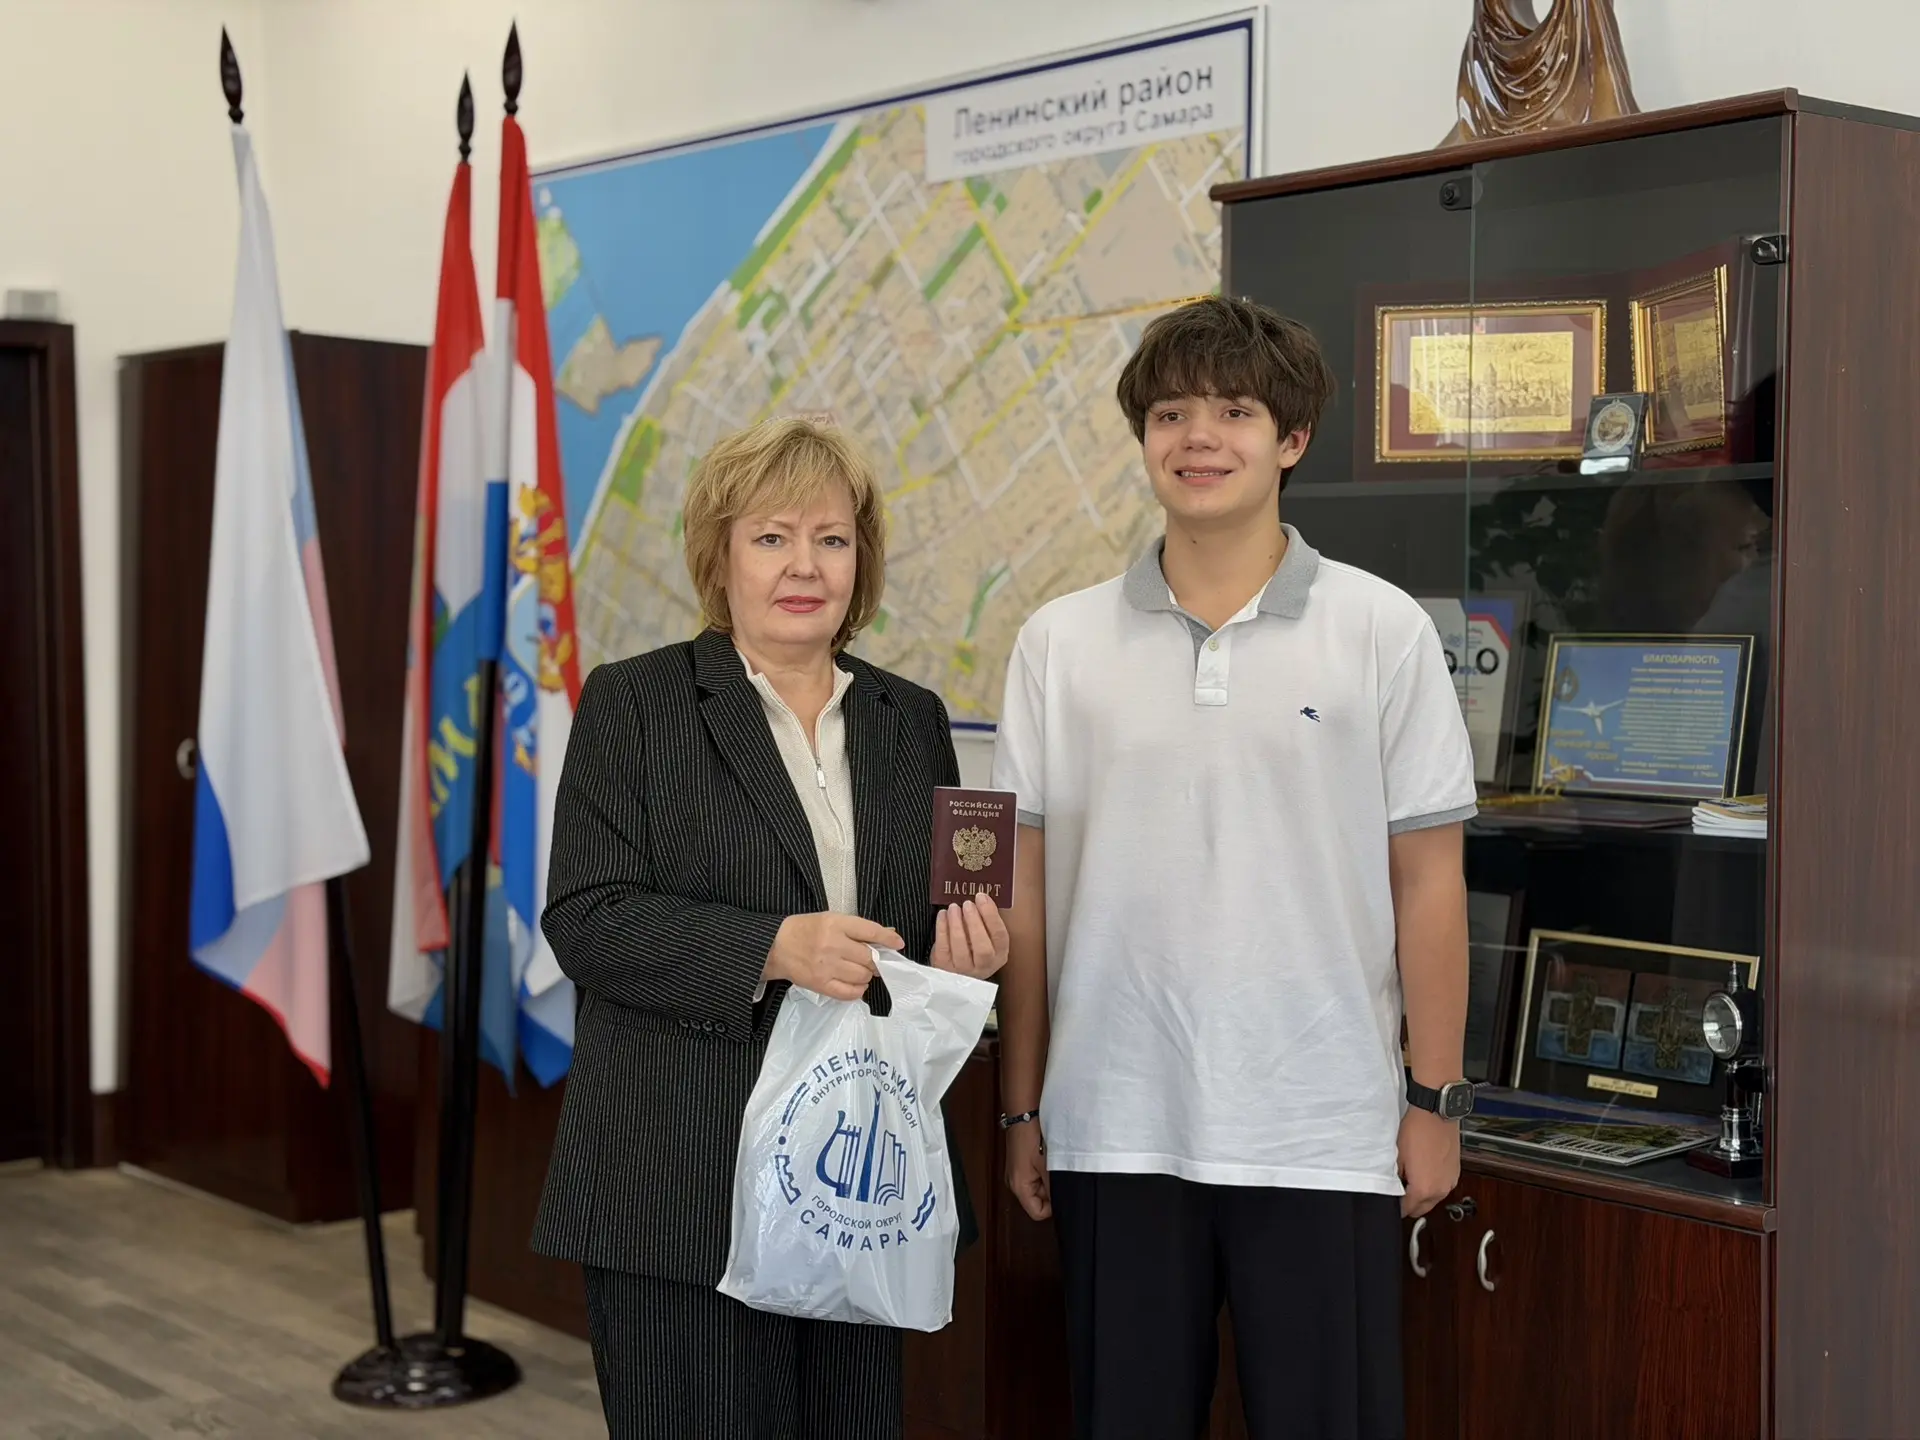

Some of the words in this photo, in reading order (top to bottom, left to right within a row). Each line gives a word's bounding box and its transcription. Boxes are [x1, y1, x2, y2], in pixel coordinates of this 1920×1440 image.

[953, 80, 1107, 139] Ленинский
[1118, 65, 1213, 114] район
[1063, 119, 1127, 147] округа
[1133, 101, 1214, 132] Самара
[949, 800, 1004, 810] РОССИЙСКАЯ
[952, 808, 1000, 818] ФЕДЕРАЦИЯ
[944, 881, 1001, 897] ПАСПОРТ
[811, 1195, 872, 1230] ГОРОДСКОЙ
[875, 1212, 903, 1229] ОКРУГ
[800, 1209, 909, 1252] САМАРА
